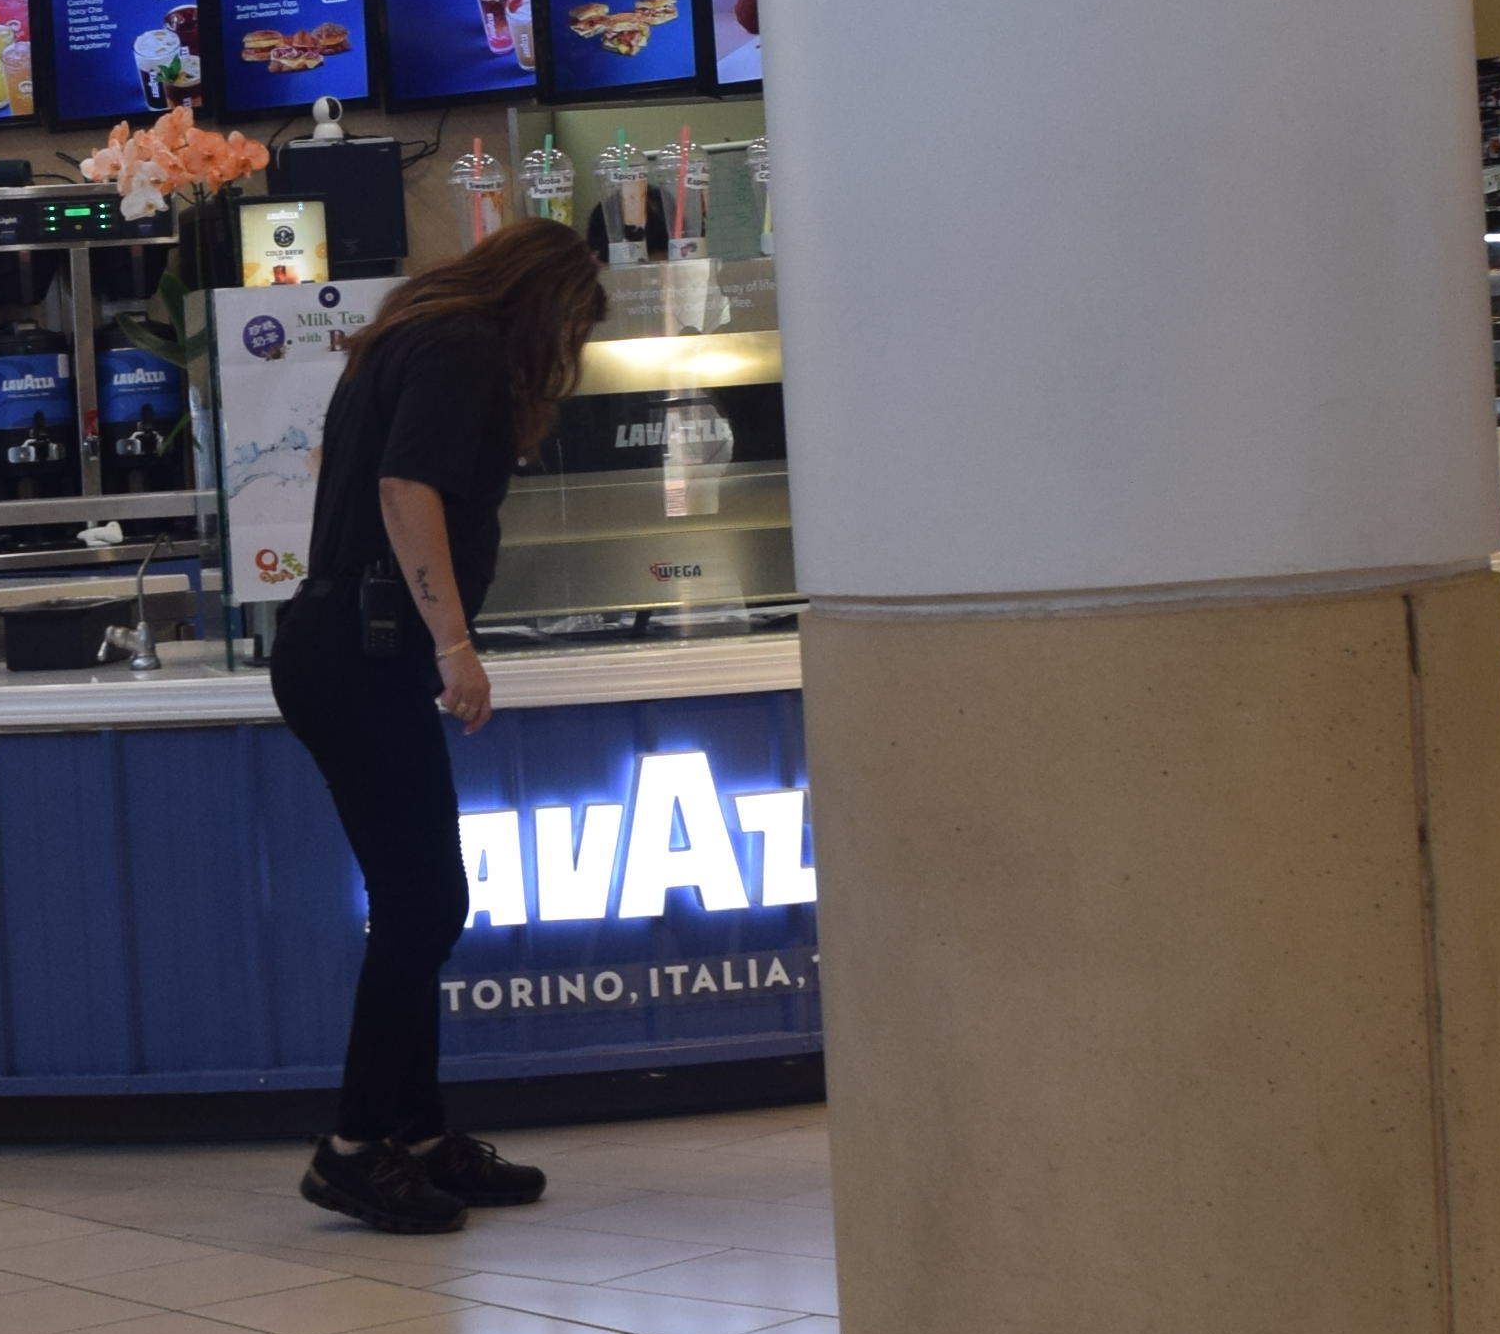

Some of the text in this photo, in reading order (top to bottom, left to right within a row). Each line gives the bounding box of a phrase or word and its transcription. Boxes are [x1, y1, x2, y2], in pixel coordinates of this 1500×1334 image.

[297, 311, 365, 327] Milk Tea
[298, 332, 322, 343] with
[2, 374, 55, 392] LAVAZZA
[113, 368, 166, 385] LAVAZZA
[615, 410, 730, 447] LAVAZZA
[659, 564, 702, 578] WEGA
[459, 750, 817, 928] AVAZ
[442, 957, 806, 1012] TORINO, ITALIA,
